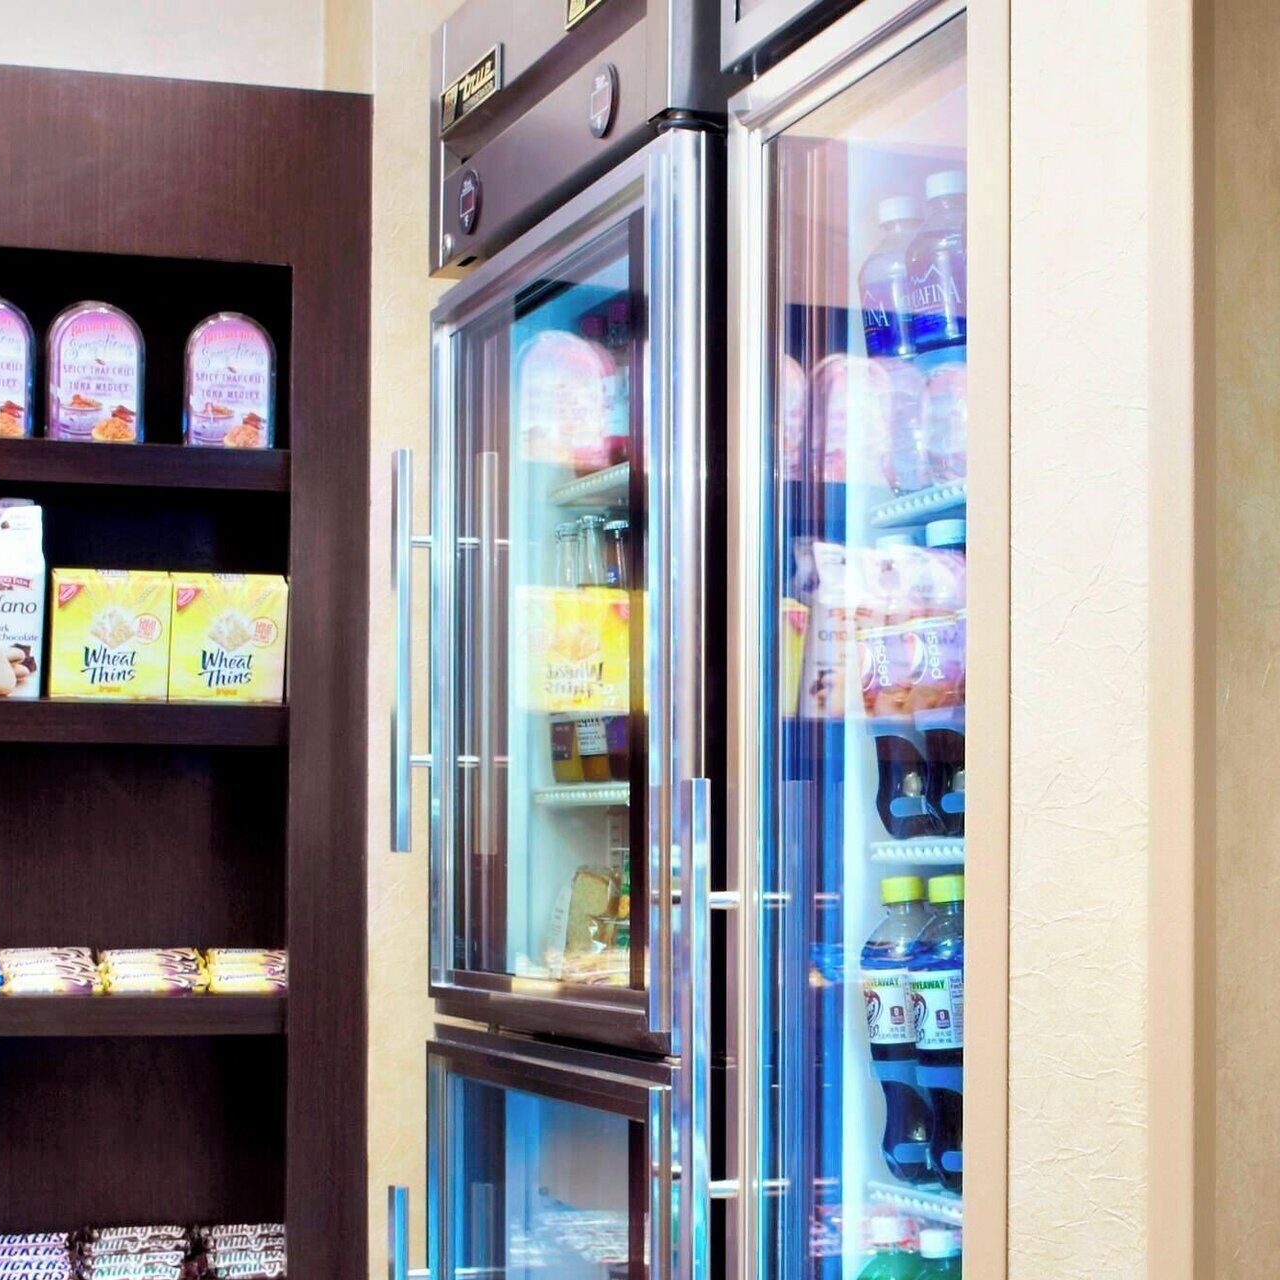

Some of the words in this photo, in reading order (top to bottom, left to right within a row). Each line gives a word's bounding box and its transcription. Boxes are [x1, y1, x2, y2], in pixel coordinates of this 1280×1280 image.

[83, 644, 137, 667] Wheat
[201, 649, 254, 670] Wheat
[874, 639, 894, 688] pepsi
[927, 629, 946, 680] pepsi
[80, 665, 136, 685] Thins
[197, 669, 252, 688] Thins
[101, 1226, 150, 1240] Milky
[95, 1253, 144, 1267] Milky
